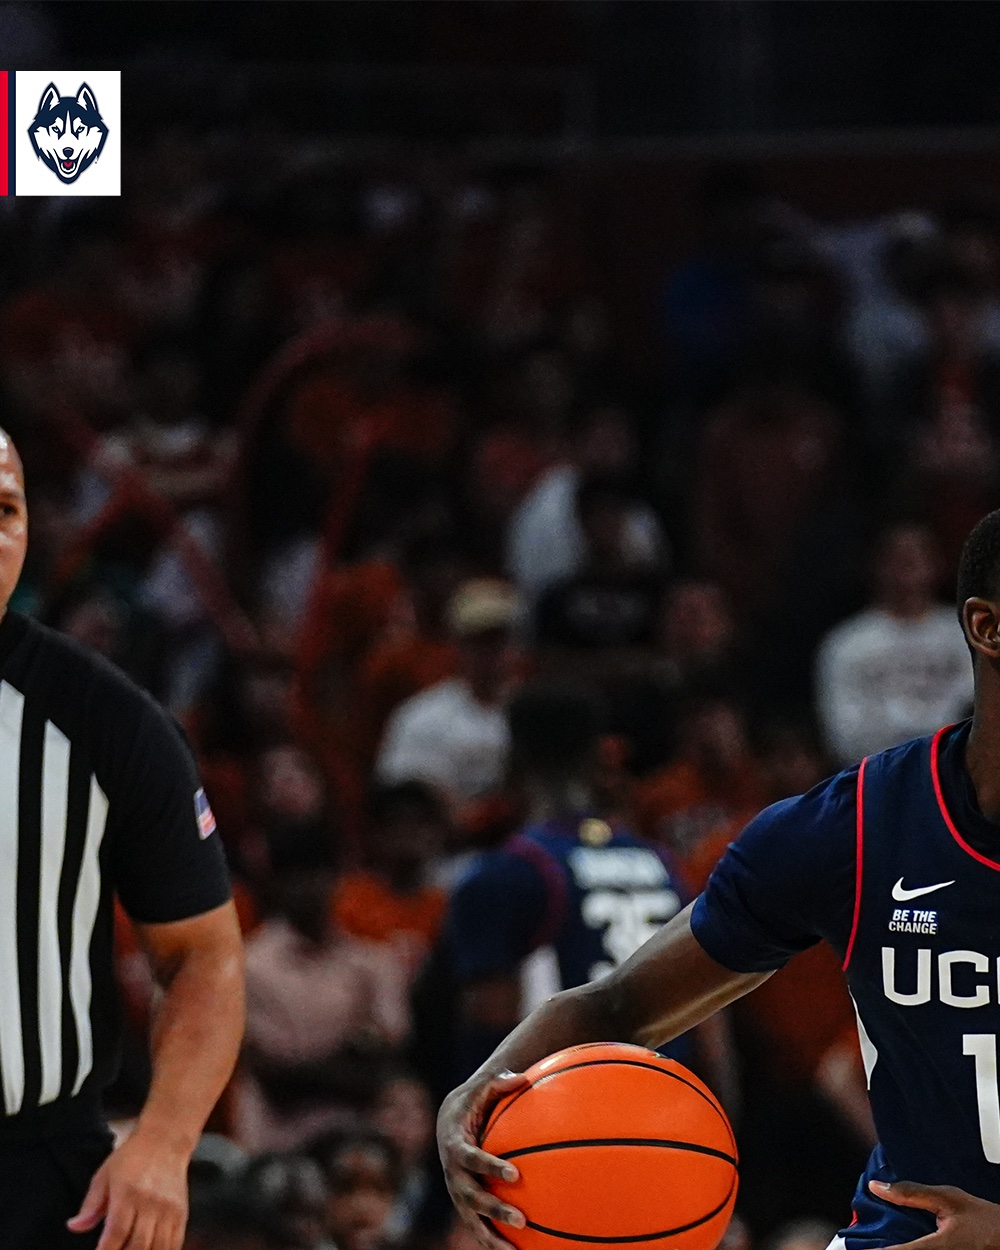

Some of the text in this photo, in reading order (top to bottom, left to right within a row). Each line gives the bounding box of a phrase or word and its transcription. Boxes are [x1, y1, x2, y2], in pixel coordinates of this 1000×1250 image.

[892, 908, 938, 923] BE THE
[888, 920, 938, 935] CHANGE
